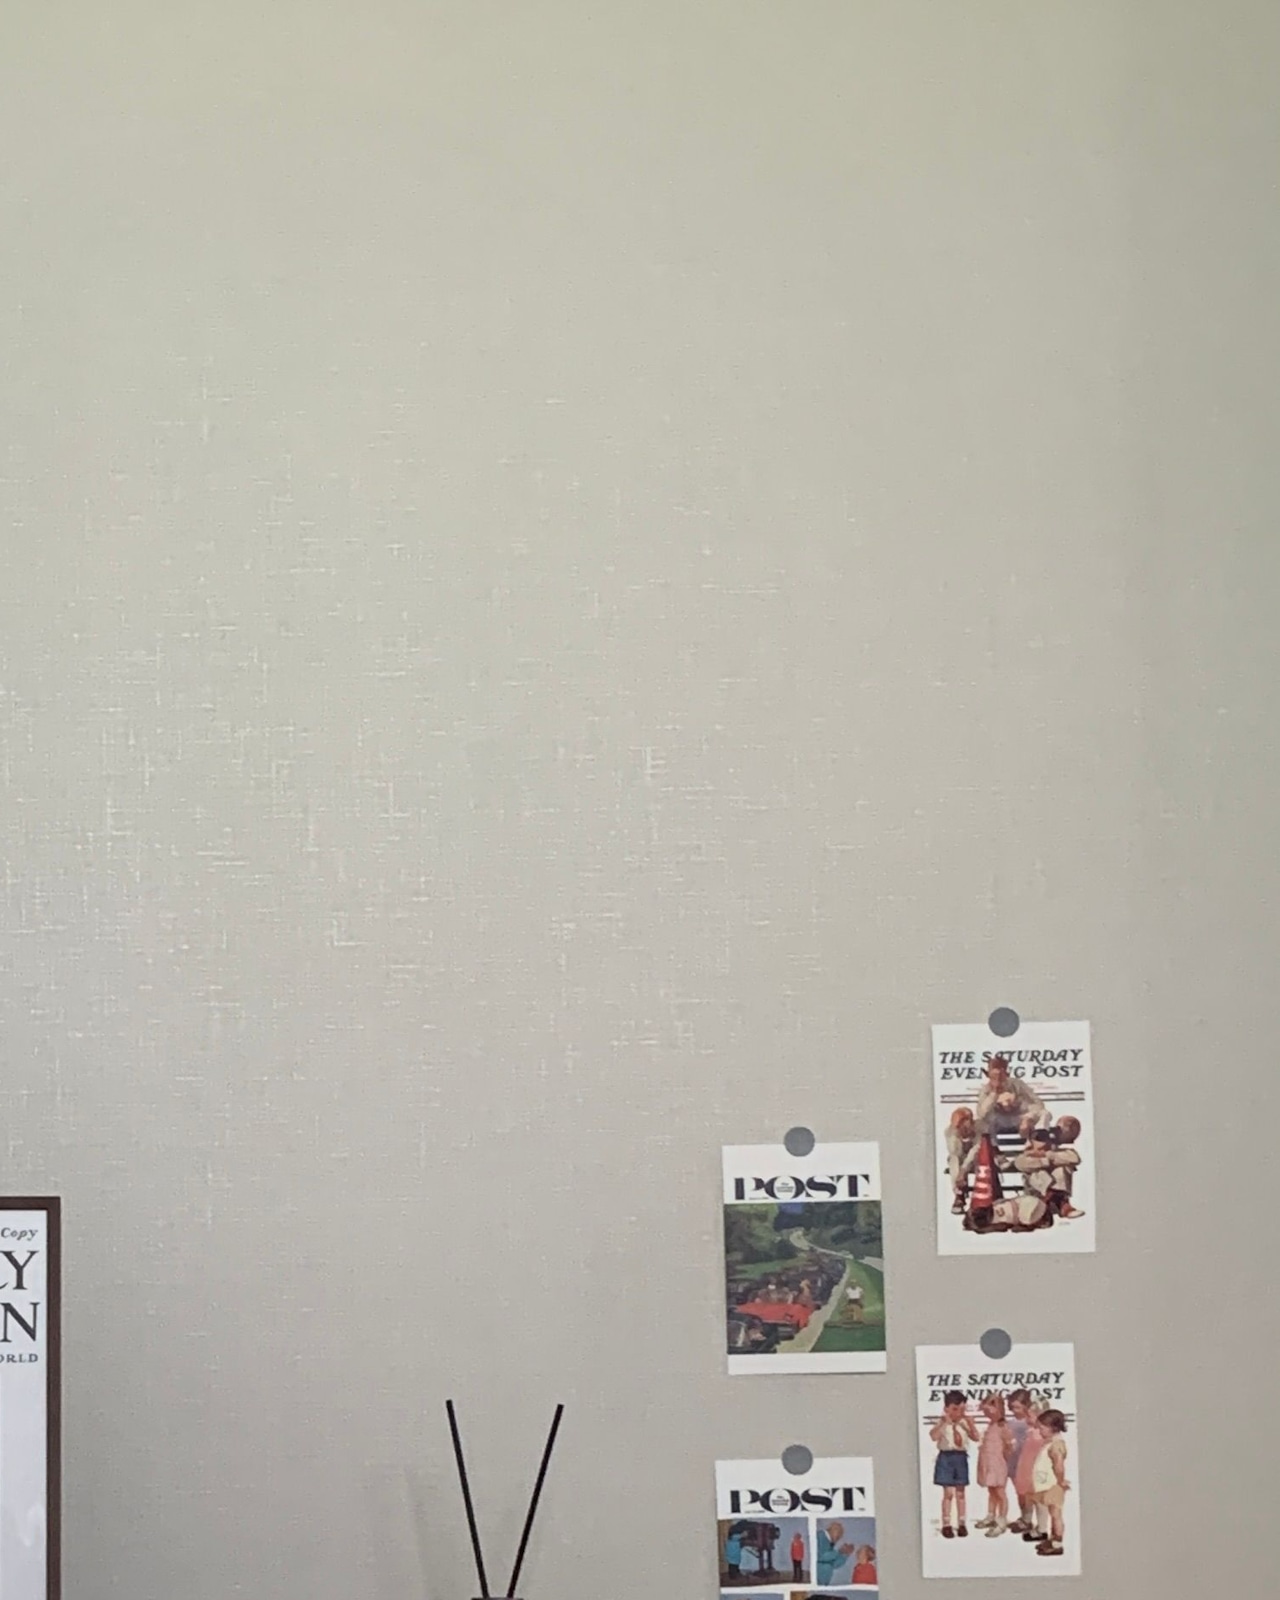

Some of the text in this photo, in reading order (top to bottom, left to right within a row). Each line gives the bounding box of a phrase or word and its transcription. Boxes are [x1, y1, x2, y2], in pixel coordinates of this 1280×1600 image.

[938, 1049, 1084, 1066] THE SATURDAY
[1031, 1065, 1084, 1078] POST
[734, 1174, 870, 1200] POST
[0, 1227, 39, 1241] Copy
[927, 1372, 1065, 1389] THE SATURDAY
[730, 1487, 866, 1513] POST
